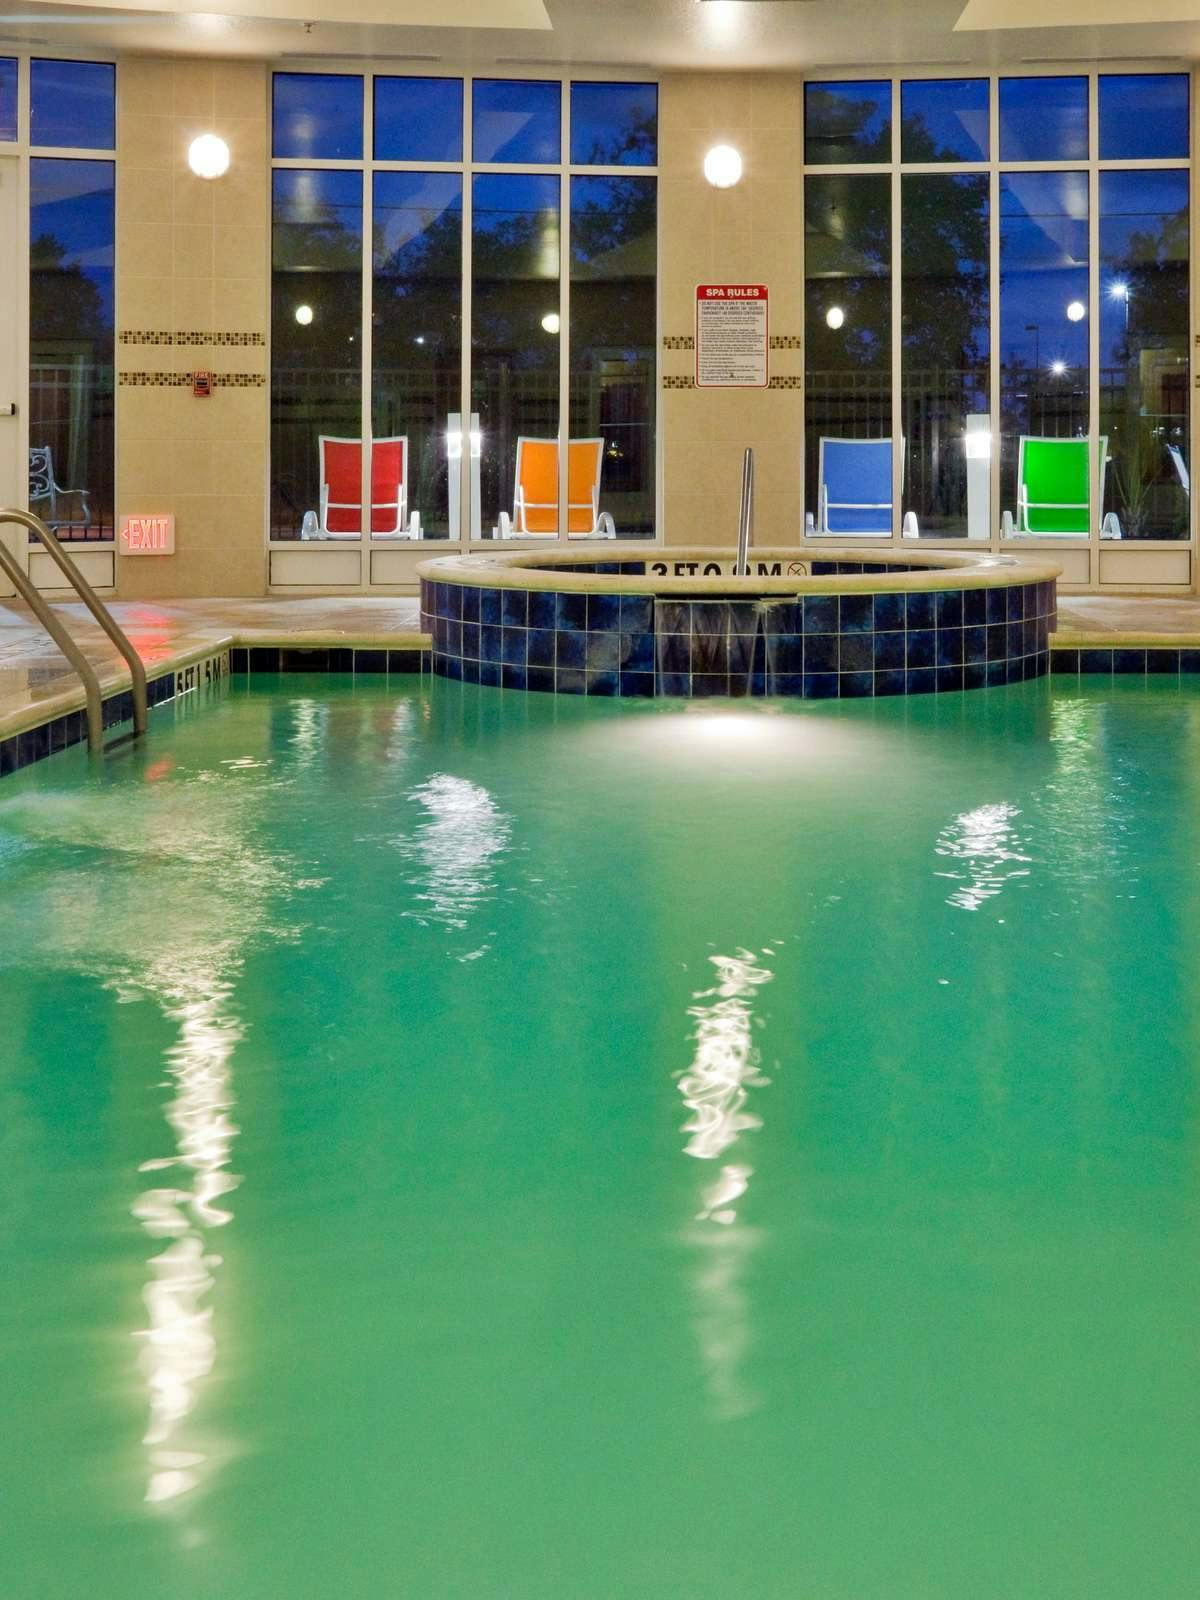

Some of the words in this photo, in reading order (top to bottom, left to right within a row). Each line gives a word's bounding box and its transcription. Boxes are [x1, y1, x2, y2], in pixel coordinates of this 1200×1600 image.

[706, 288, 725, 296] SPA
[727, 288, 760, 296] RULES
[129, 519, 169, 549] EXIT
